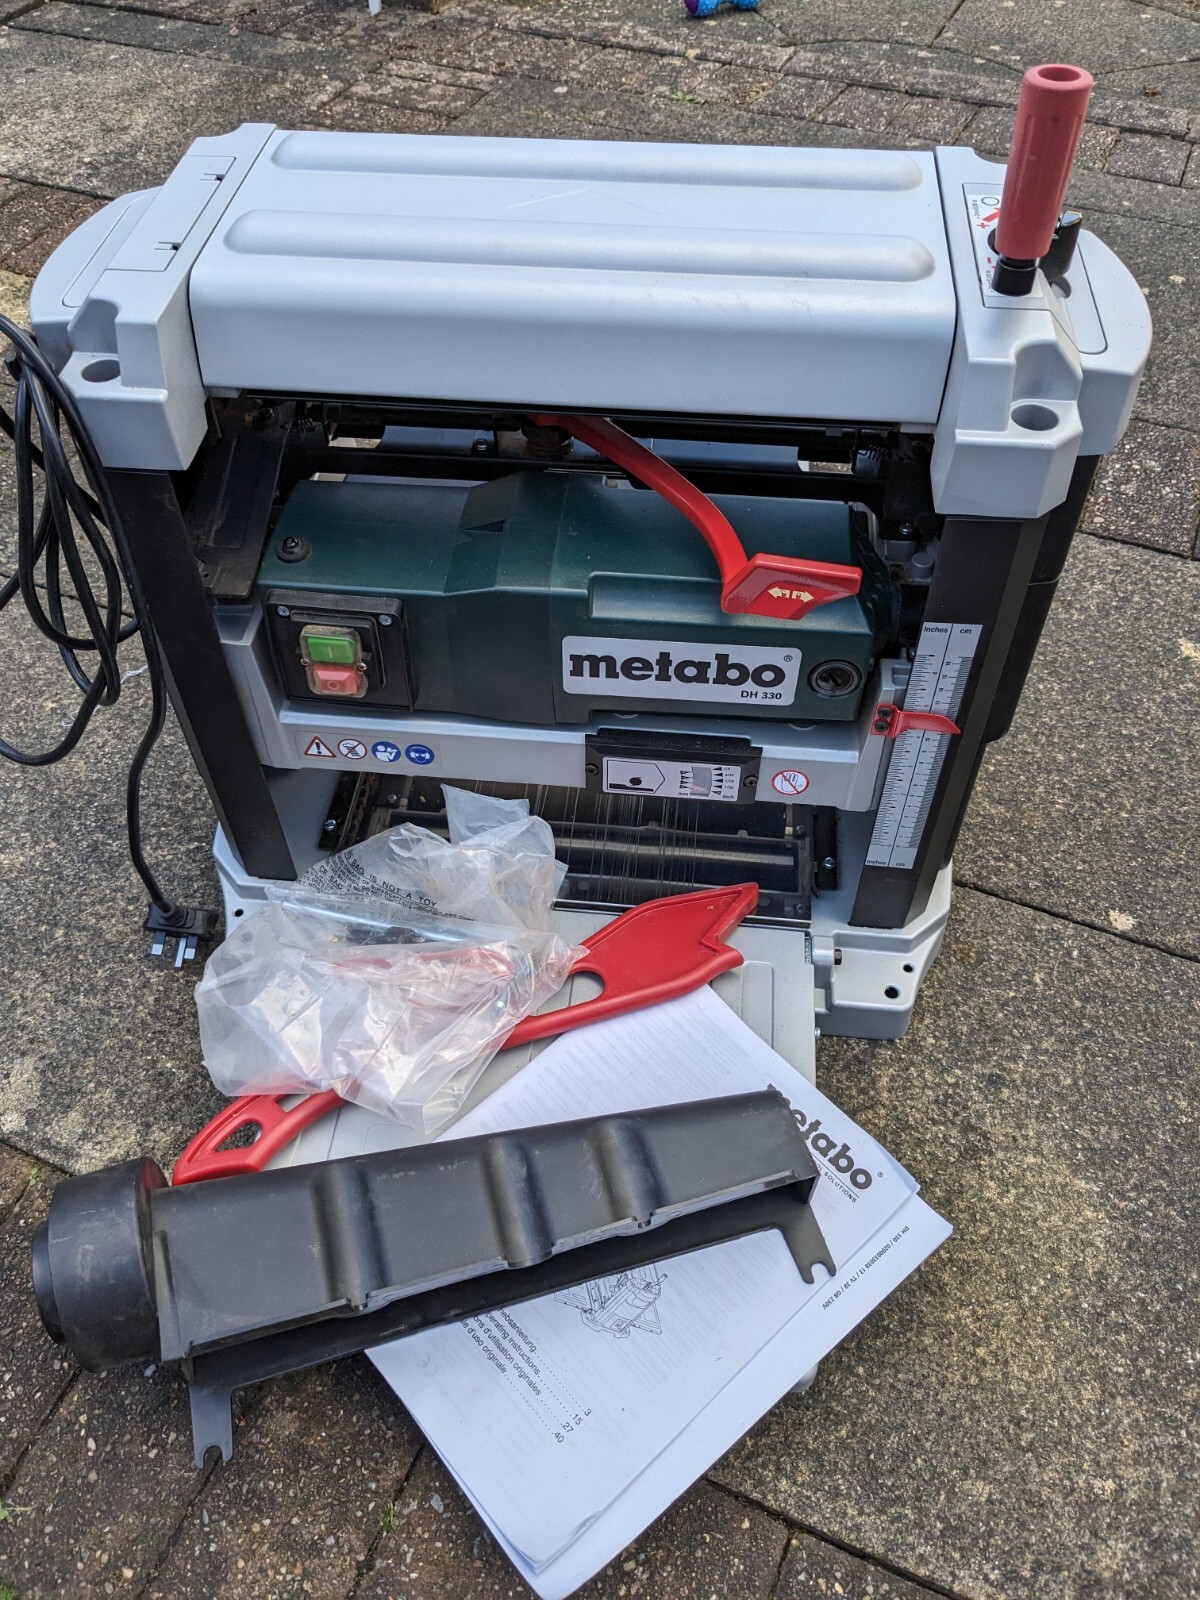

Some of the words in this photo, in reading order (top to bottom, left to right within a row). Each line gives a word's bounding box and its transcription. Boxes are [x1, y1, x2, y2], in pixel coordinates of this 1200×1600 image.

[924, 626, 949, 634] inches
[740, 690, 758, 700] DH
[761, 691, 782, 700] 330
[351, 859, 365, 876] BAG
[369, 873, 378, 884] IS
[382, 881, 402, 894] NOT
[405, 892, 412, 900] A
[418, 896, 438, 908] TOY
[767, 1083, 873, 1190] etabo
[823, 1171, 858, 1204] SOLUTIONS
[901, 1225, 910, 1235] DH
[467, 1327, 484, 1347] d'uso
[482, 1345, 508, 1374] originale
[554, 1431, 565, 1444] 40
[508, 1336, 541, 1376] instructions
[572, 1413, 584, 1426] 15
[512, 1362, 542, 1396] originales
[562, 1422, 575, 1435] 27
[584, 1408, 592, 1417] 3
